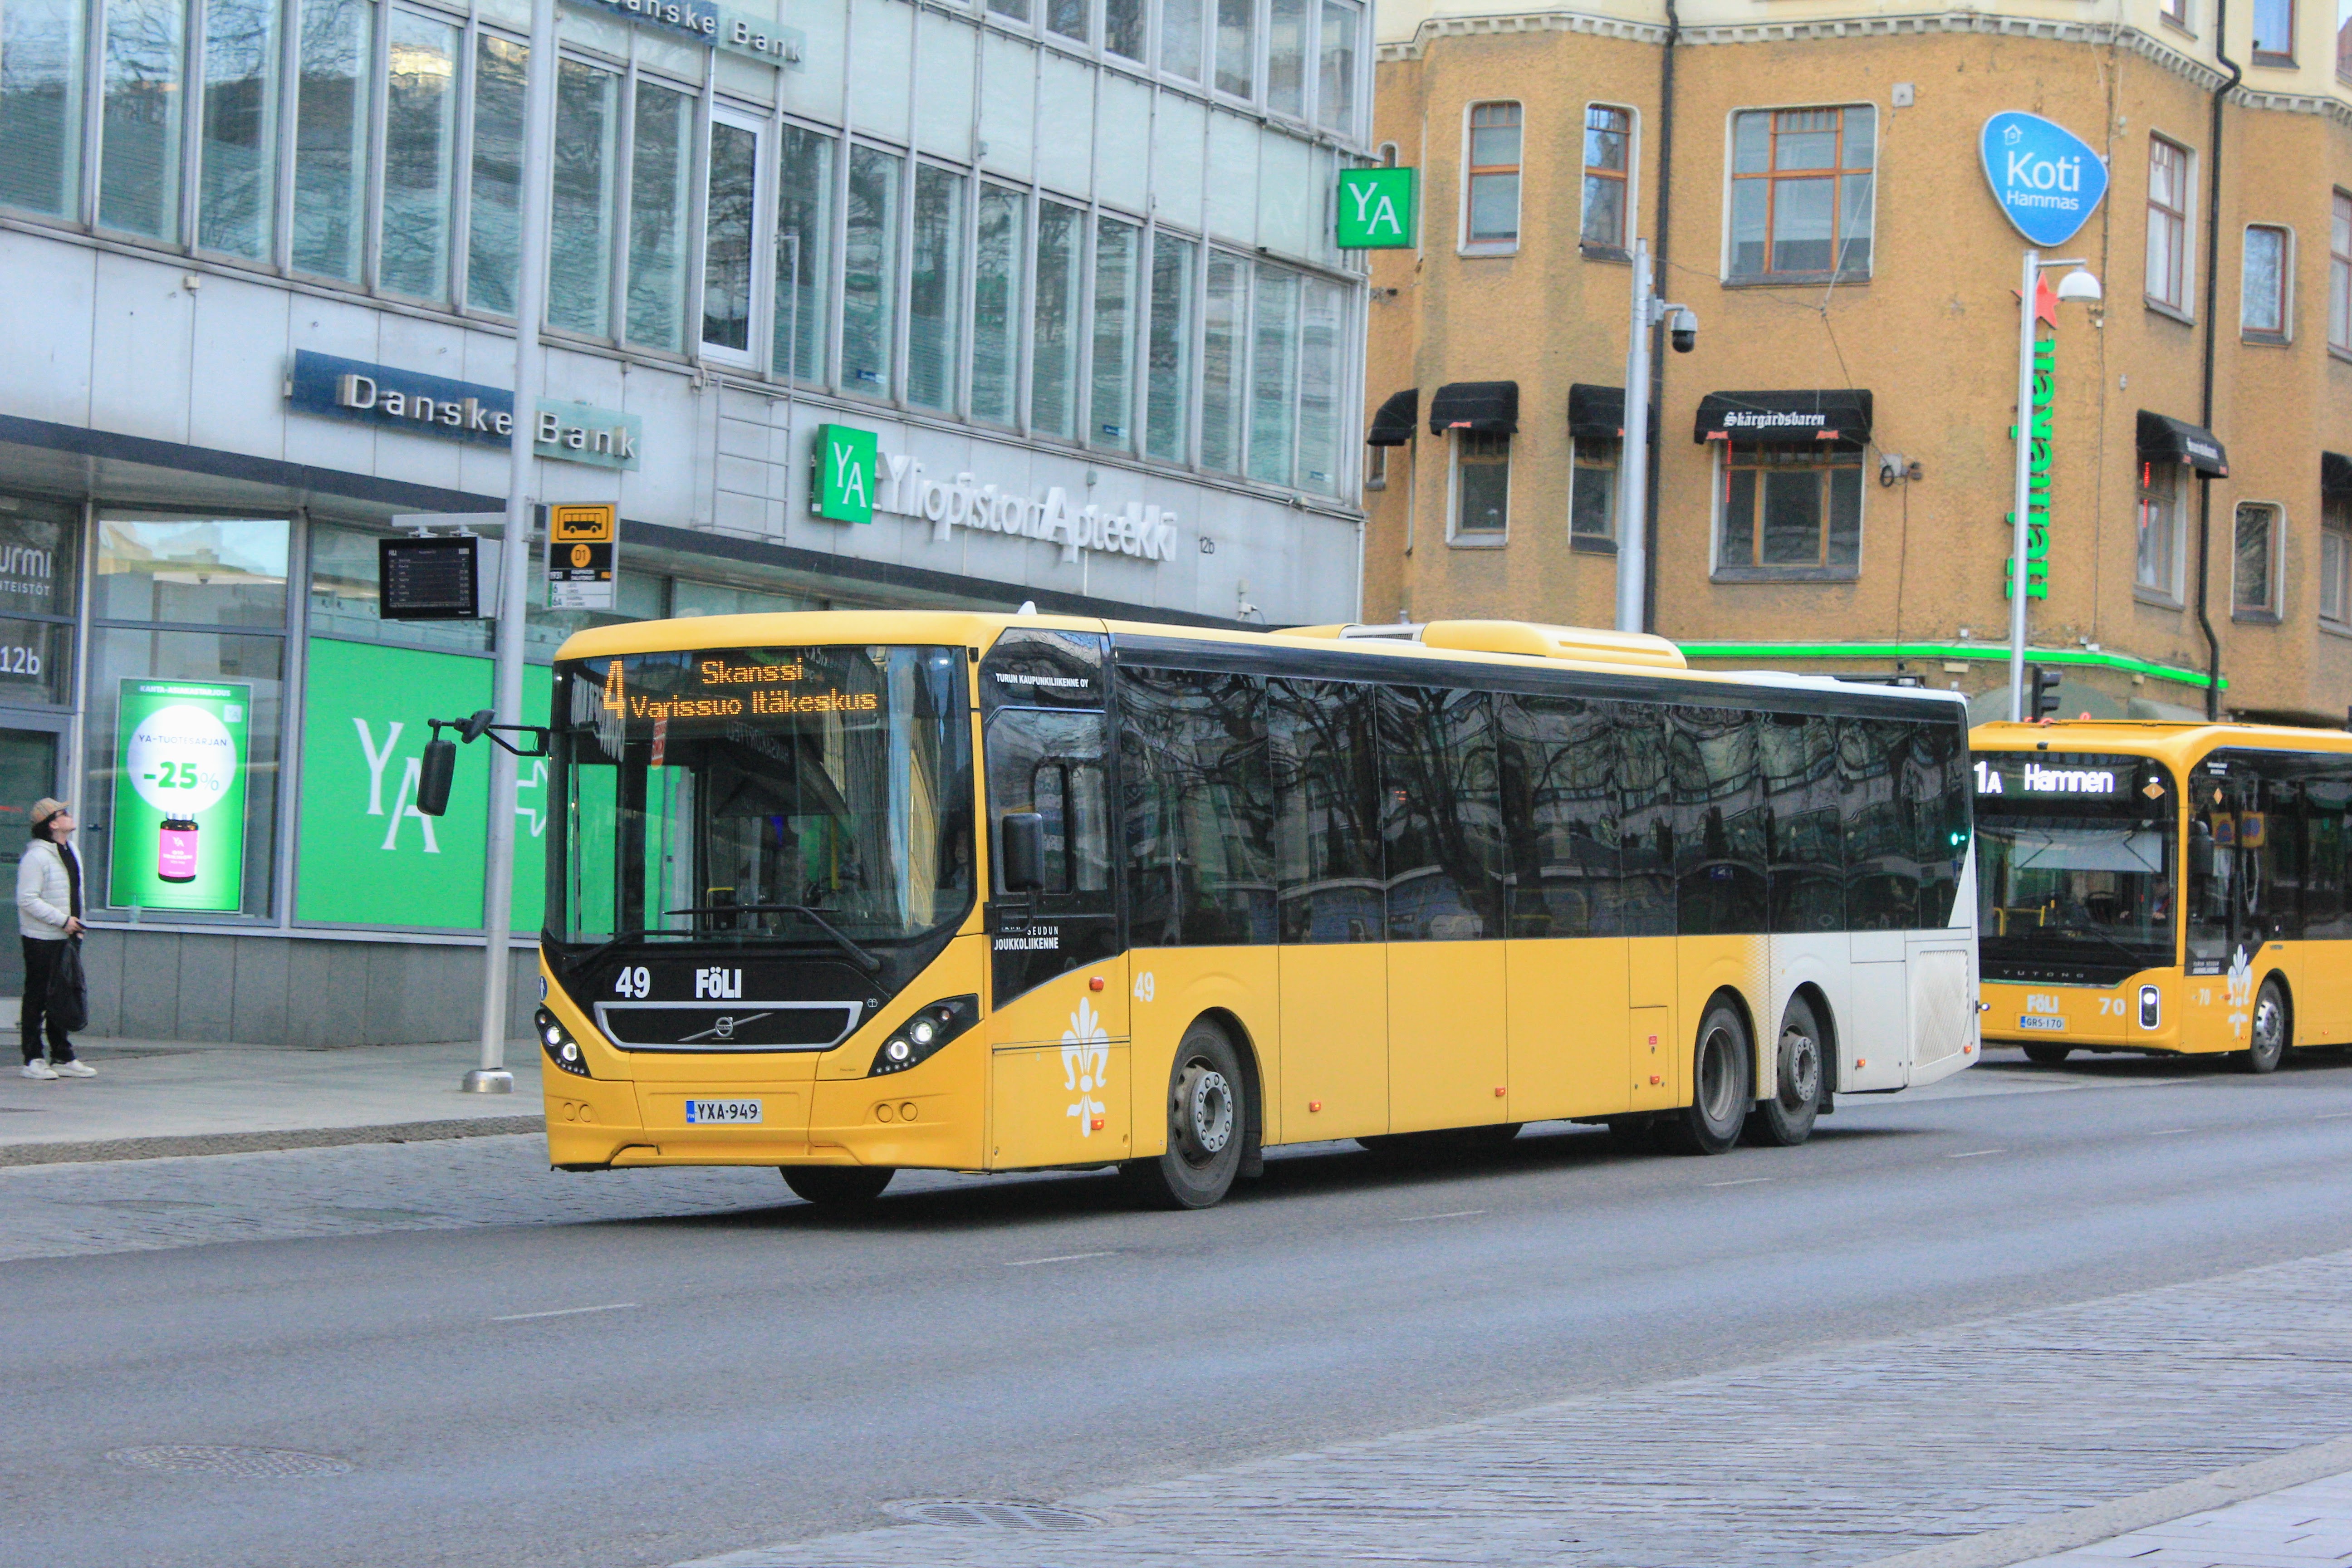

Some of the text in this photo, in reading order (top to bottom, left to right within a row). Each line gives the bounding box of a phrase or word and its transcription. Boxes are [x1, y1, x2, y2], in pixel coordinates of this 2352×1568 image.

[605, 0, 801, 62] anske Bank
[2007, 151, 2080, 191] Koti
[1348, 182, 1402, 235] YA
[2007, 190, 2079, 211] Hammas
[348, 374, 635, 459] Danske Bank
[1724, 411, 1825, 429] Skärgårdsbaren
[833, 442, 867, 508] YA
[575, 549, 586, 560] D1
[1199, 536, 1215, 554] 12b
[554, 583, 558, 593] 6
[0, 646, 40, 675] 12b
[701, 657, 803, 684] Skanssi
[139, 685, 231, 697] KANTA-ASIAKASTARJOUS
[603, 660, 625, 719] 4
[995, 673, 1088, 688] TURUN KAUPUNKILIIKENNE OY
[630, 687, 878, 718] Varissuo Itäkeskus
[139, 734, 227, 746] YA-TUOTESARJAN
[353, 718, 441, 853] YA
[1974, 760, 2003, 794] 1A
[2024, 763, 2115, 794] Hamnen
[994, 937, 1059, 951] JOUKKOLIIKENNE
[615, 966, 651, 998] 49
[696, 966, 742, 998] FÖLI
[1134, 971, 1155, 1002] 49
[2004, 969, 2084, 978] YUTONG
[2098, 997, 2127, 1015] 70
[2026, 1018, 2063, 1028] GRS-170
[697, 1103, 758, 1120] YXA-949
